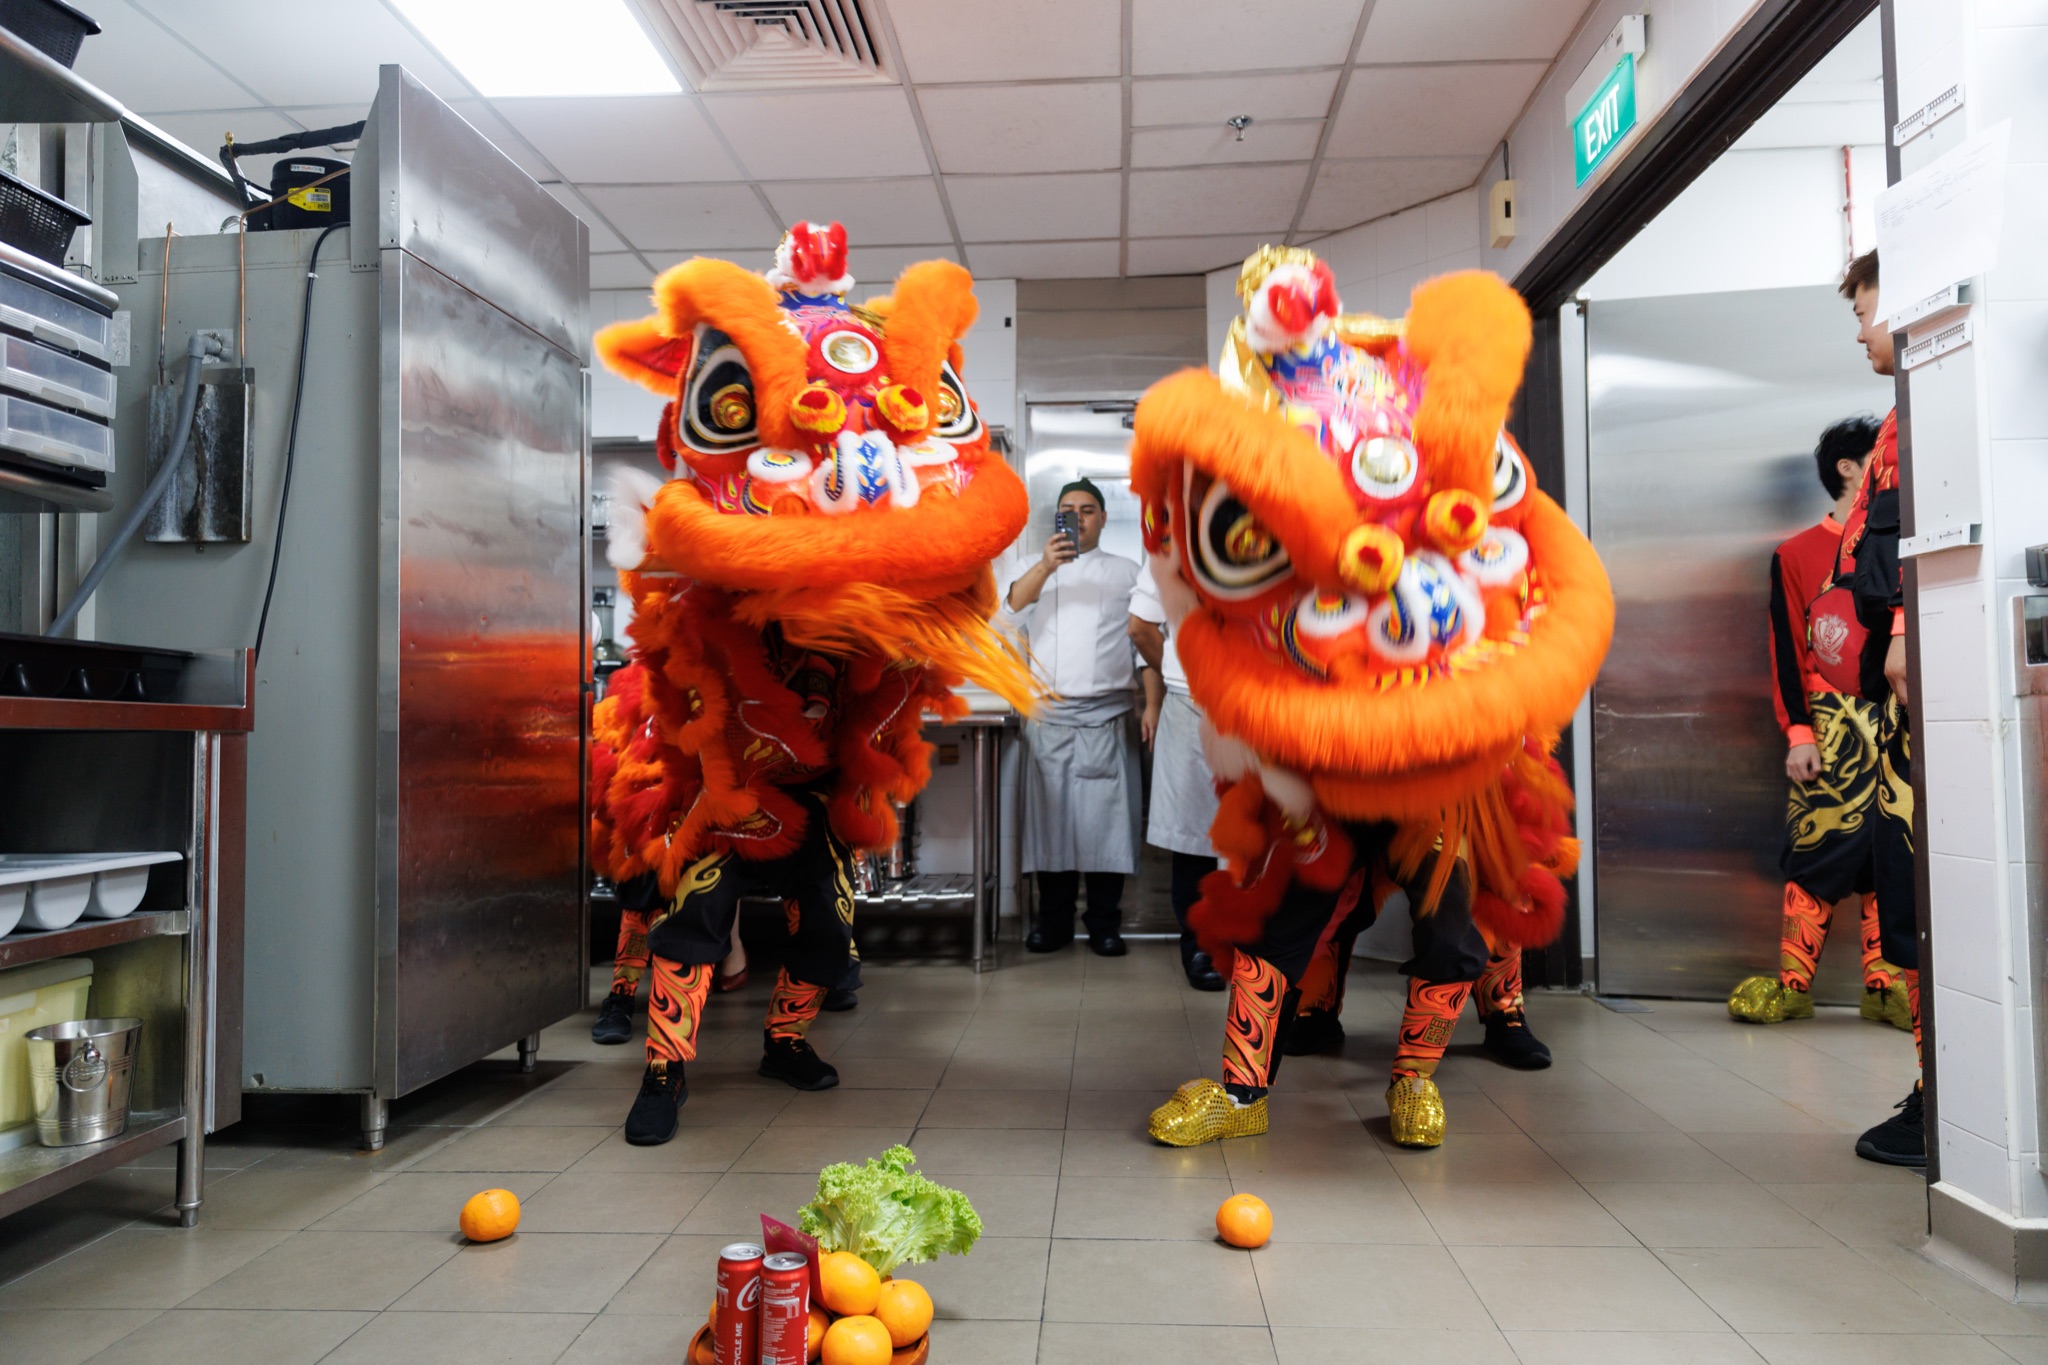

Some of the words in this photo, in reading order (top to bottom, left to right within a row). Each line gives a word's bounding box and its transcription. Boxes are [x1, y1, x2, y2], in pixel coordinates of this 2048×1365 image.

[1585, 83, 1620, 165] EXIT
[735, 1322, 743, 1337] ME
[734, 1339, 742, 1365] CYCLE
